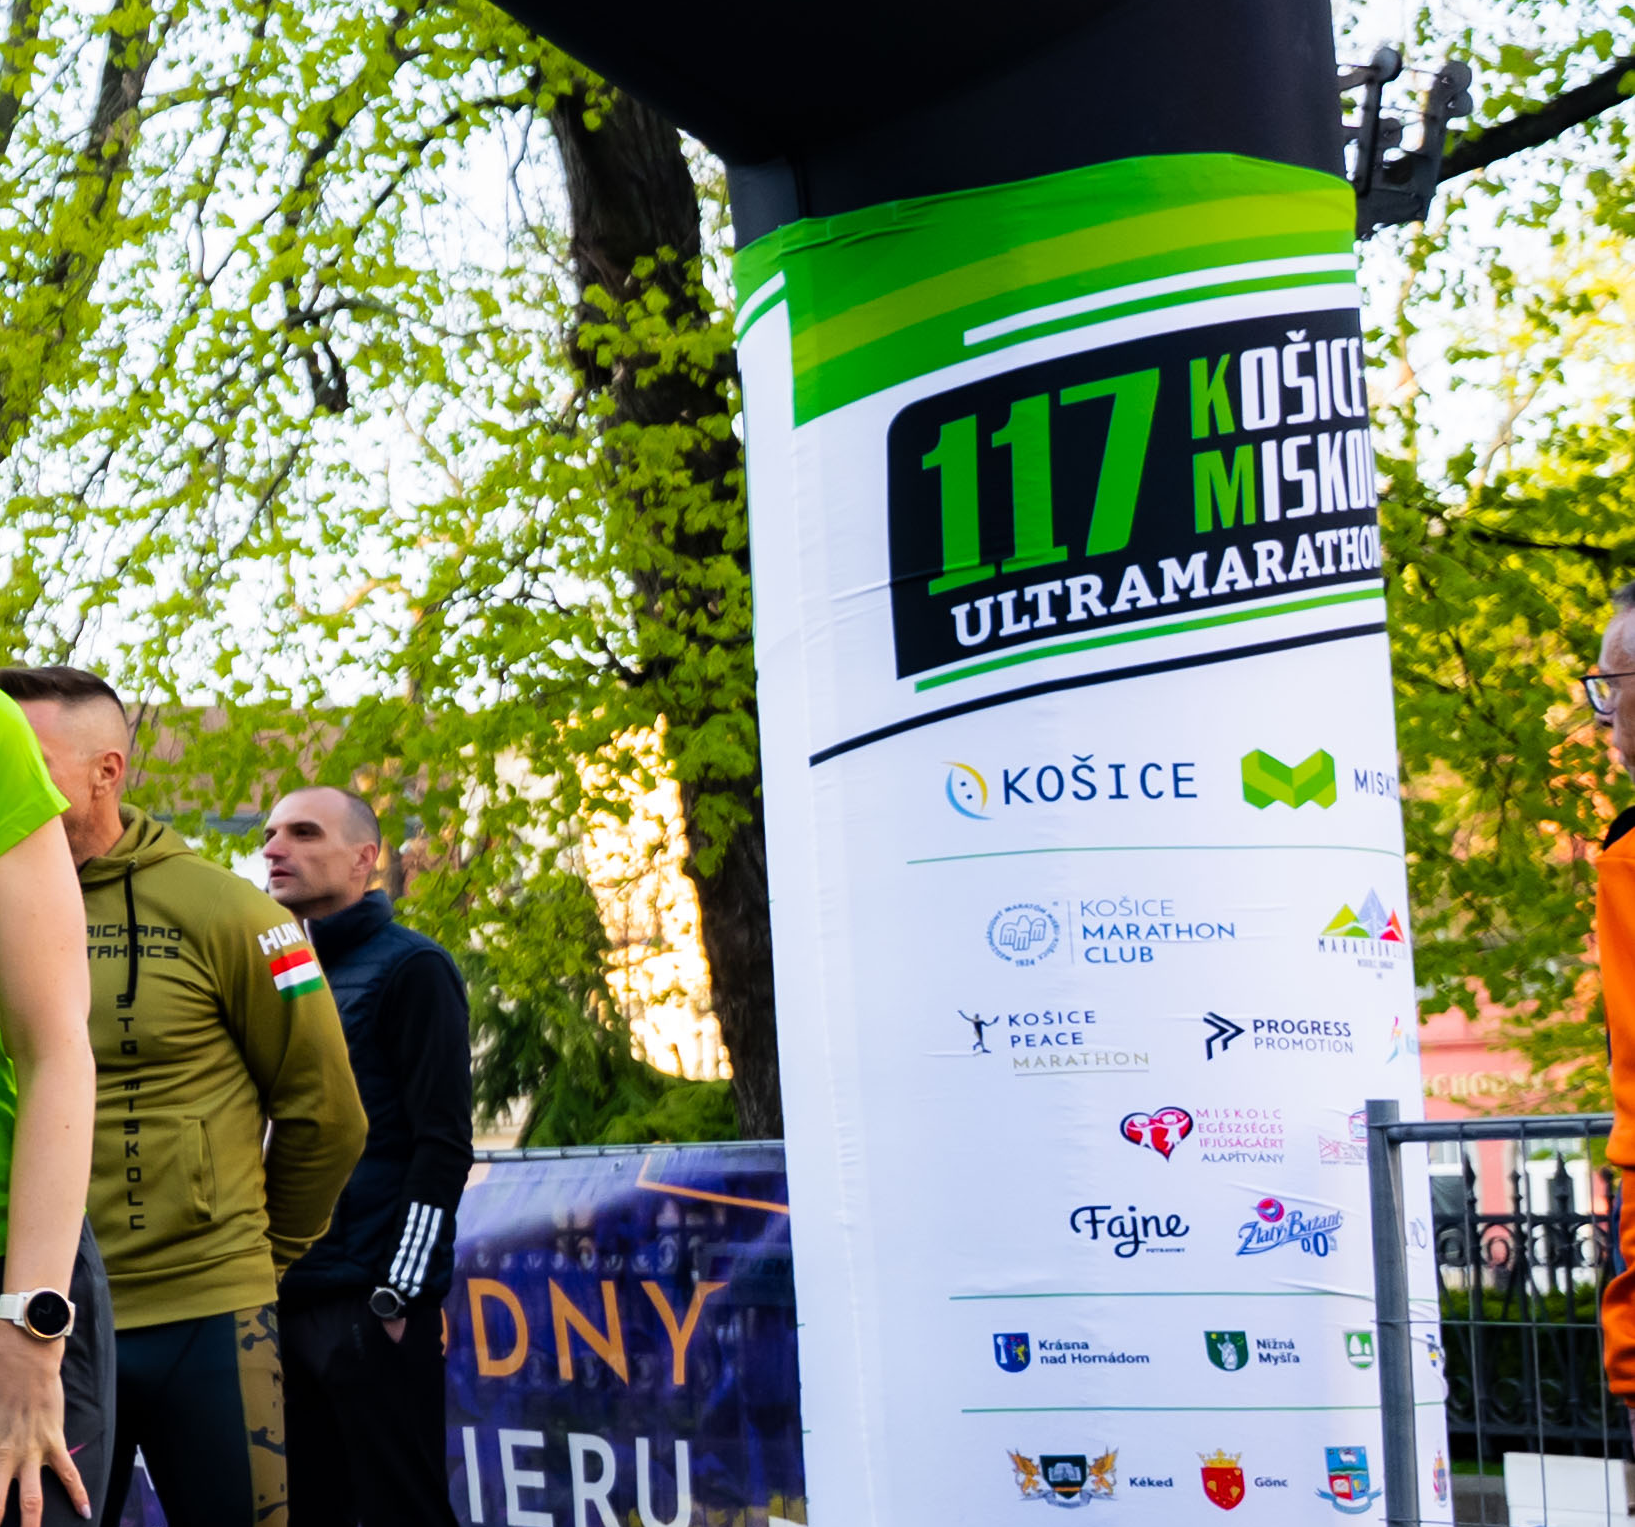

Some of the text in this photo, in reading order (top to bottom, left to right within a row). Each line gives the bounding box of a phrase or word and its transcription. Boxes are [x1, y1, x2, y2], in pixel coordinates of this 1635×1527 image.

[921, 330, 1366, 597] 117 KOŠICE
[1194, 429, 1378, 534] MISKOL
[1002, 754, 1199, 806] KOŠICE
[1080, 896, 1175, 917] KOŠICE
[258, 922, 306, 956] HUN
[1082, 922, 1235, 941] MARATHON
[1084, 946, 1154, 964] CLUB
[1008, 1010, 1097, 1027] KOŠICE
[1253, 1018, 1352, 1037] PROGRESS
[1010, 1032, 1084, 1048] PEACE
[1254, 1037, 1354, 1054] PROMOTION
[1013, 1051, 1150, 1070] MARATHON
[1196, 1108, 1281, 1119] MISKOLC
[1070, 1205, 1190, 1258] Fajne
[1038, 1338, 1090, 1353] Krásna
[1256, 1337, 1296, 1351] Nižná
[1040, 1352, 1151, 1365] nad Hornádom
[1129, 1475, 1174, 1489] Kéked
[1254, 1475, 1289, 1490] Gönc
